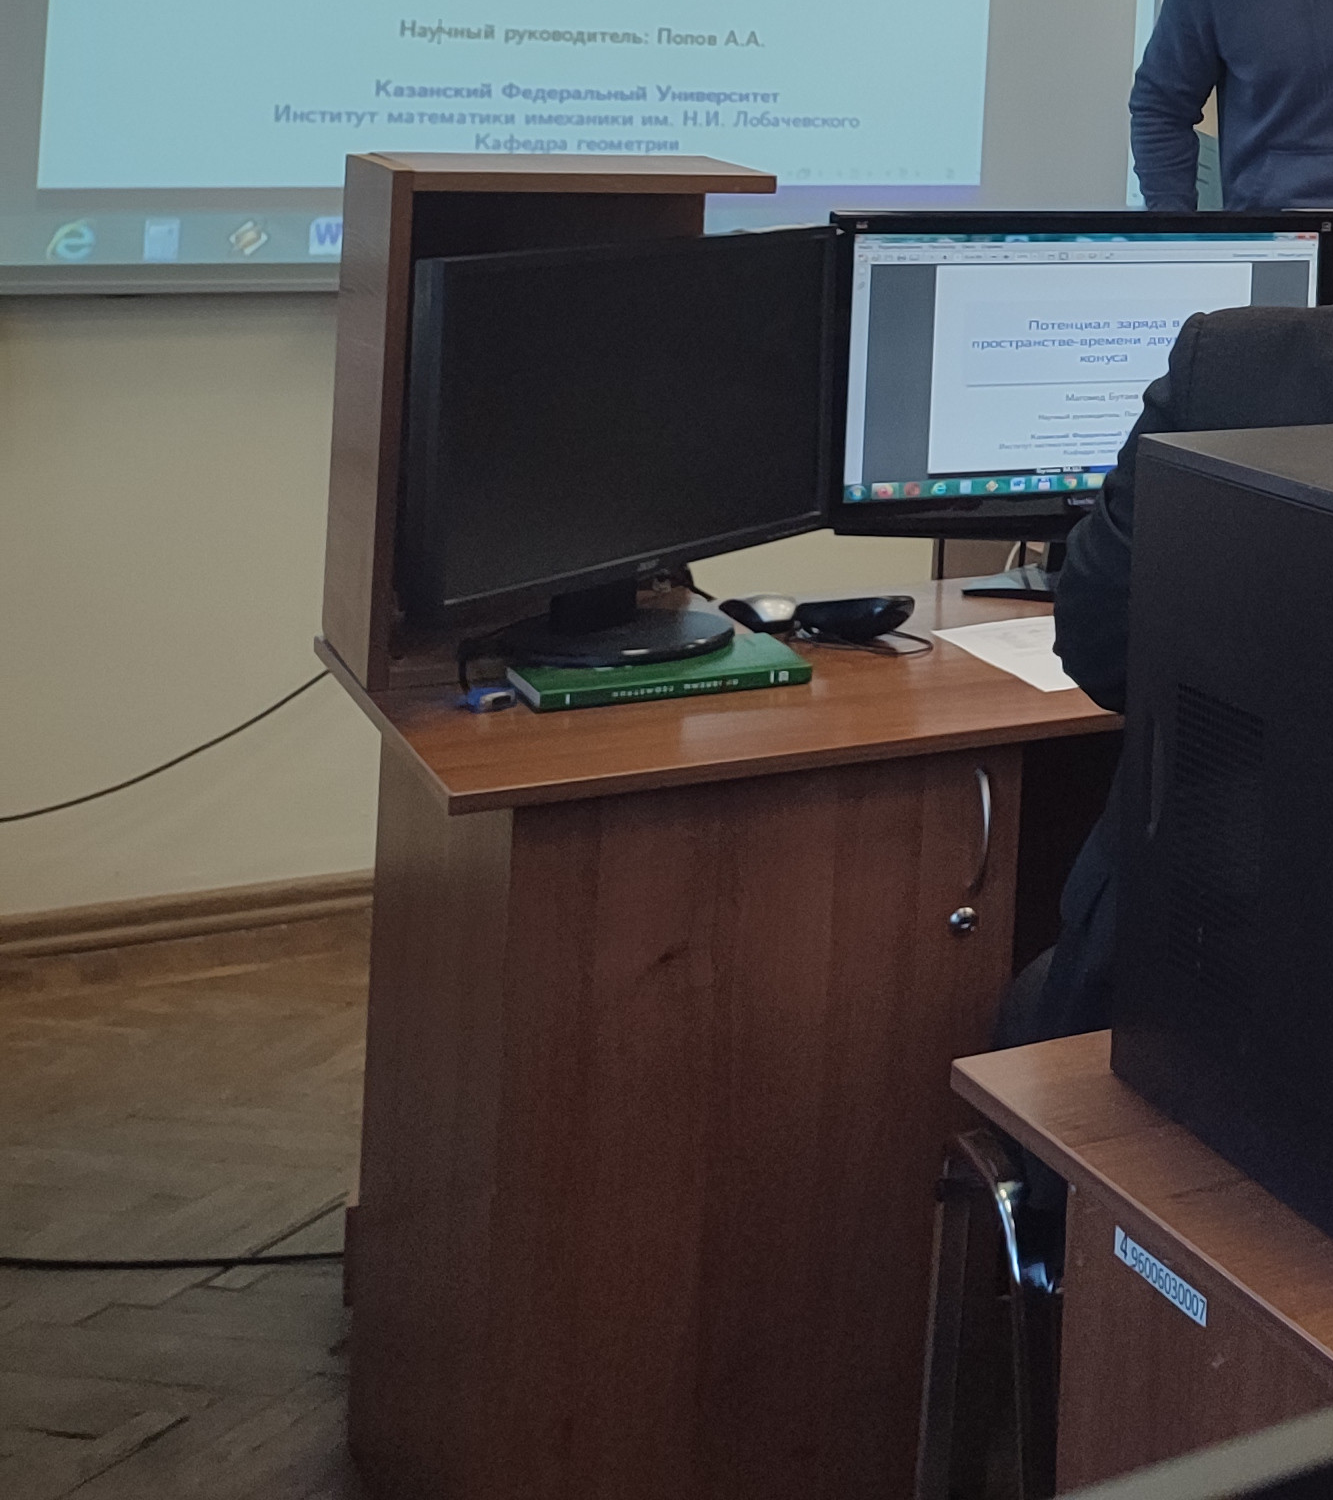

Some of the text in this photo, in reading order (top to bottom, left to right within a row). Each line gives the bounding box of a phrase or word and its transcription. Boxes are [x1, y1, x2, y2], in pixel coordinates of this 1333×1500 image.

[399, 18, 496, 46] Научный
[504, 25, 650, 49] руководитель:
[657, 27, 718, 49] Попов
[374, 79, 780, 108] Казанский Федеральный Университет
[274, 104, 379, 129] Институт
[387, 109, 516, 127] математики
[732, 111, 861, 130] Лобачевского
[475, 133, 680, 155] Кафедра геометрии
[1028, 319, 1180, 331] Потенциал заряда в
[972, 336, 1141, 350] пространстве-времени
[1080, 354, 1128, 365] конуса
[1120, 1234, 1206, 1321] 4 96006030007
